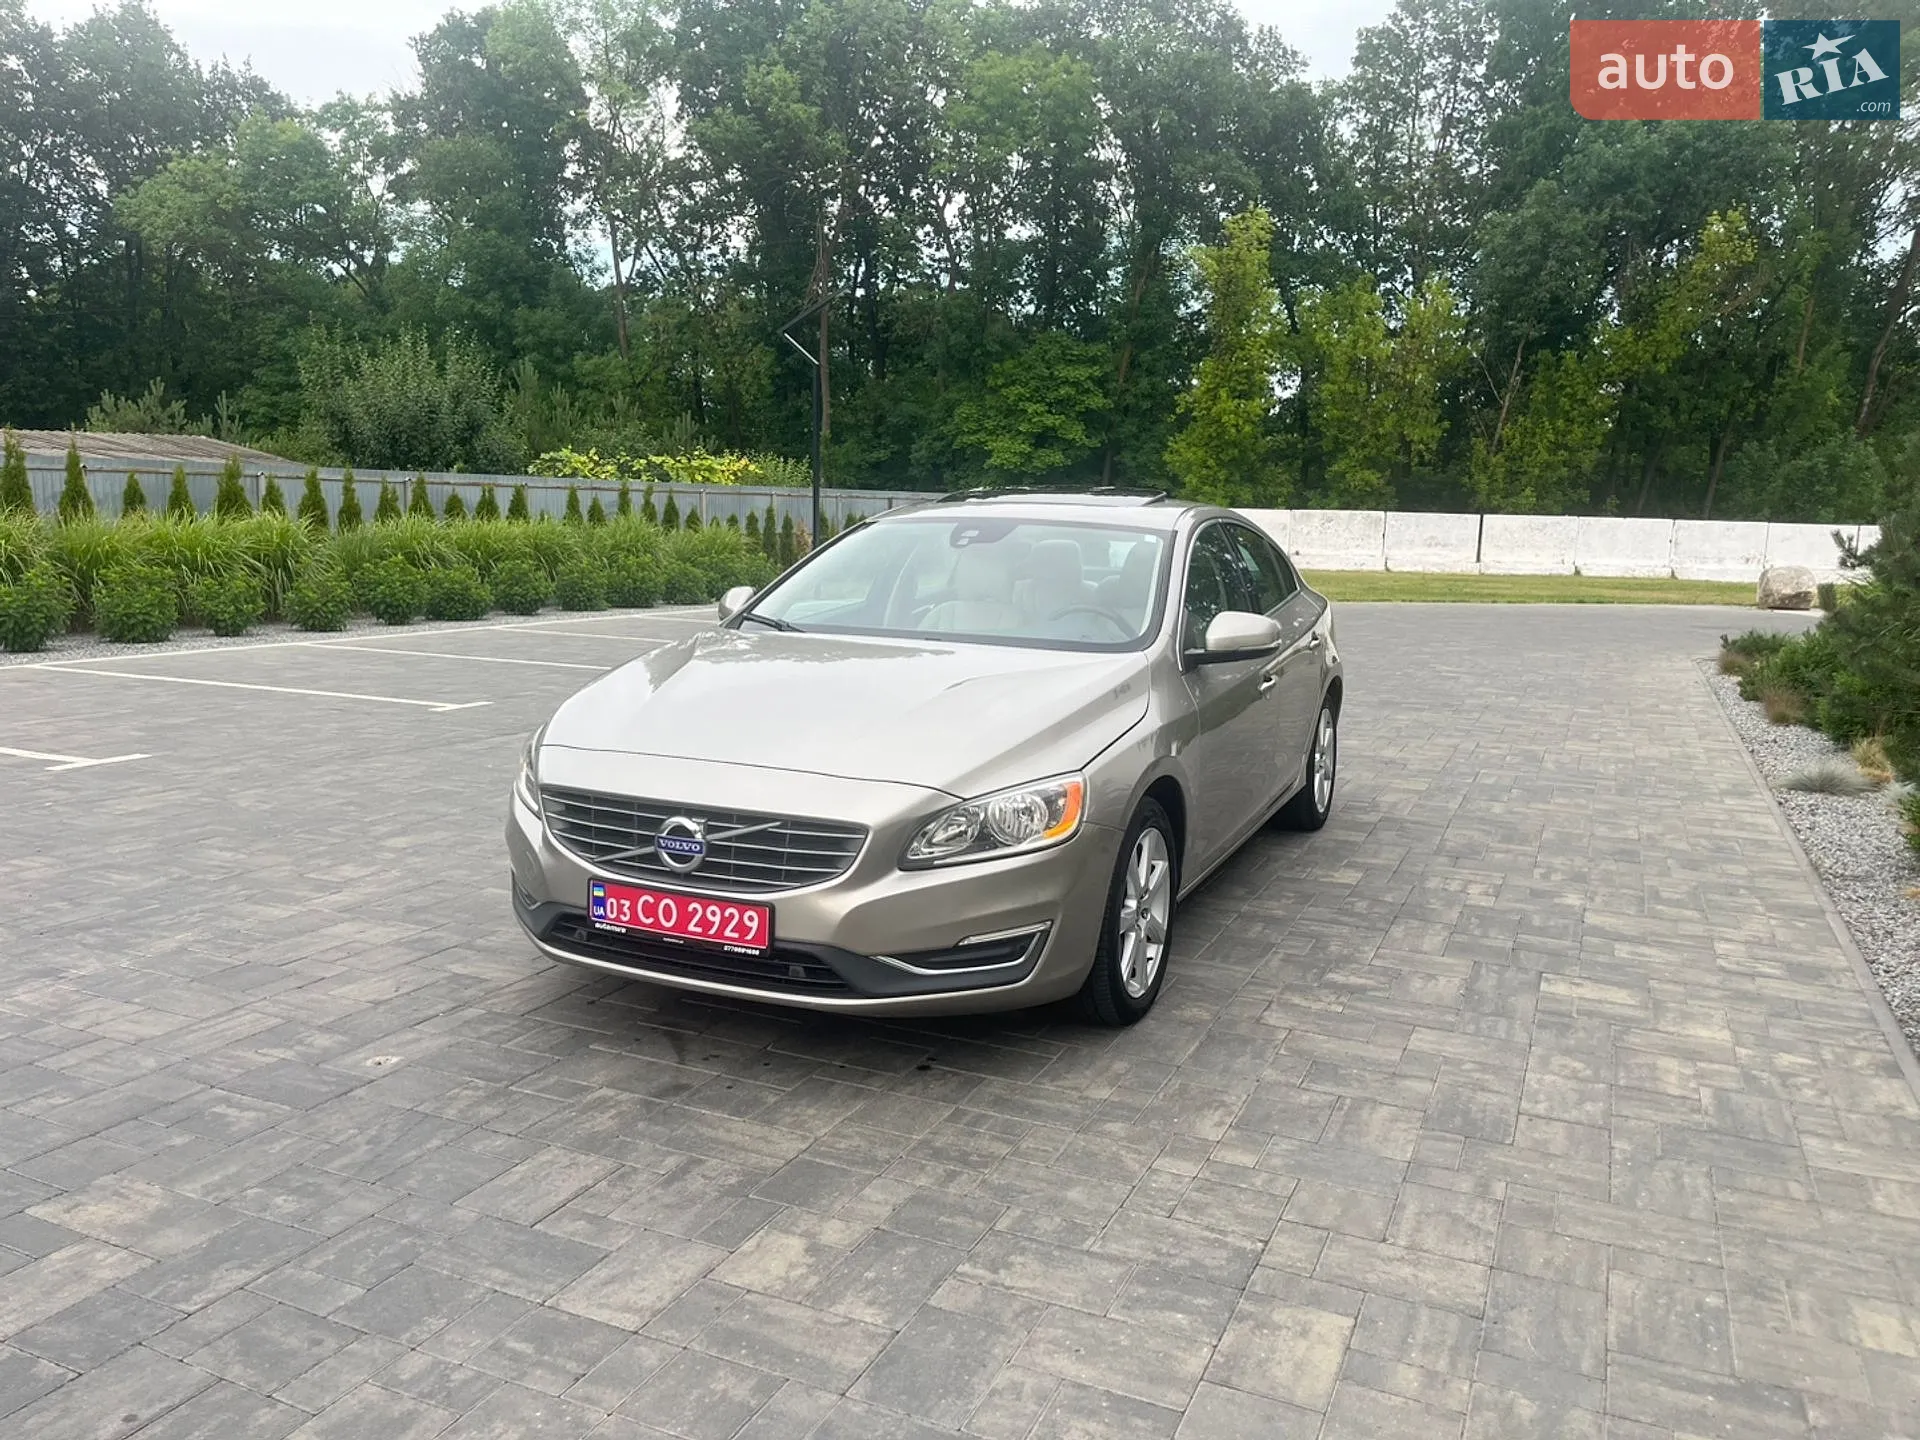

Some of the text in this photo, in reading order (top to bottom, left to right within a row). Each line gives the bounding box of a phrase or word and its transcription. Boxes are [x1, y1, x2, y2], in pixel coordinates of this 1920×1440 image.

[658, 838, 700, 852] VOLVO
[593, 905, 605, 917] UA
[606, 894, 759, 940] 03 CO 2929
